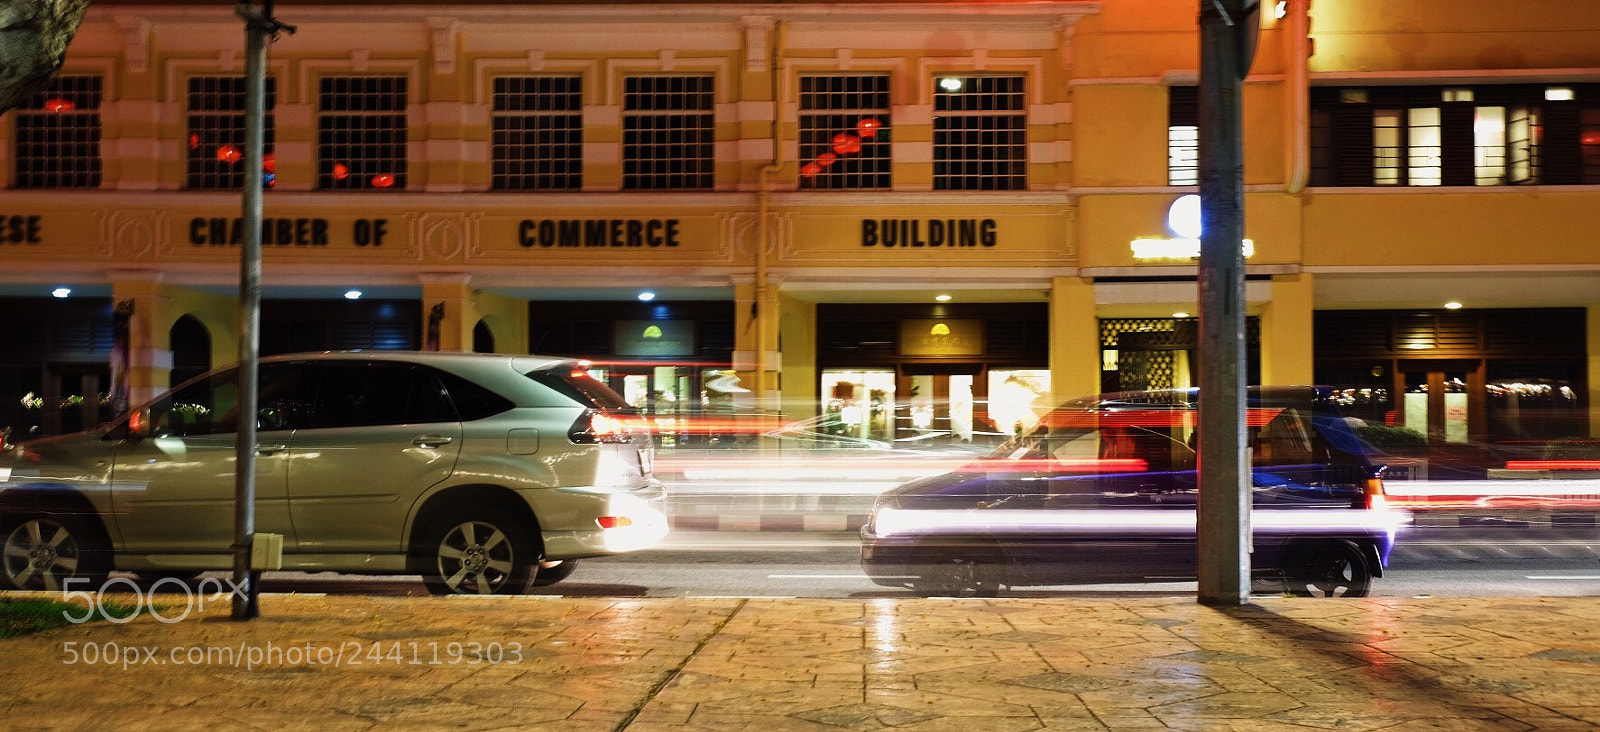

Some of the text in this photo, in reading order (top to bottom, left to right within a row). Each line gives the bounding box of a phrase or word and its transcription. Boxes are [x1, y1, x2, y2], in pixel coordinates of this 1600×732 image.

[189, 217, 329, 246] CHAMBER
[353, 218, 388, 246] OF
[518, 219, 680, 247] COMMERCE
[861, 219, 997, 247] BUILDING
